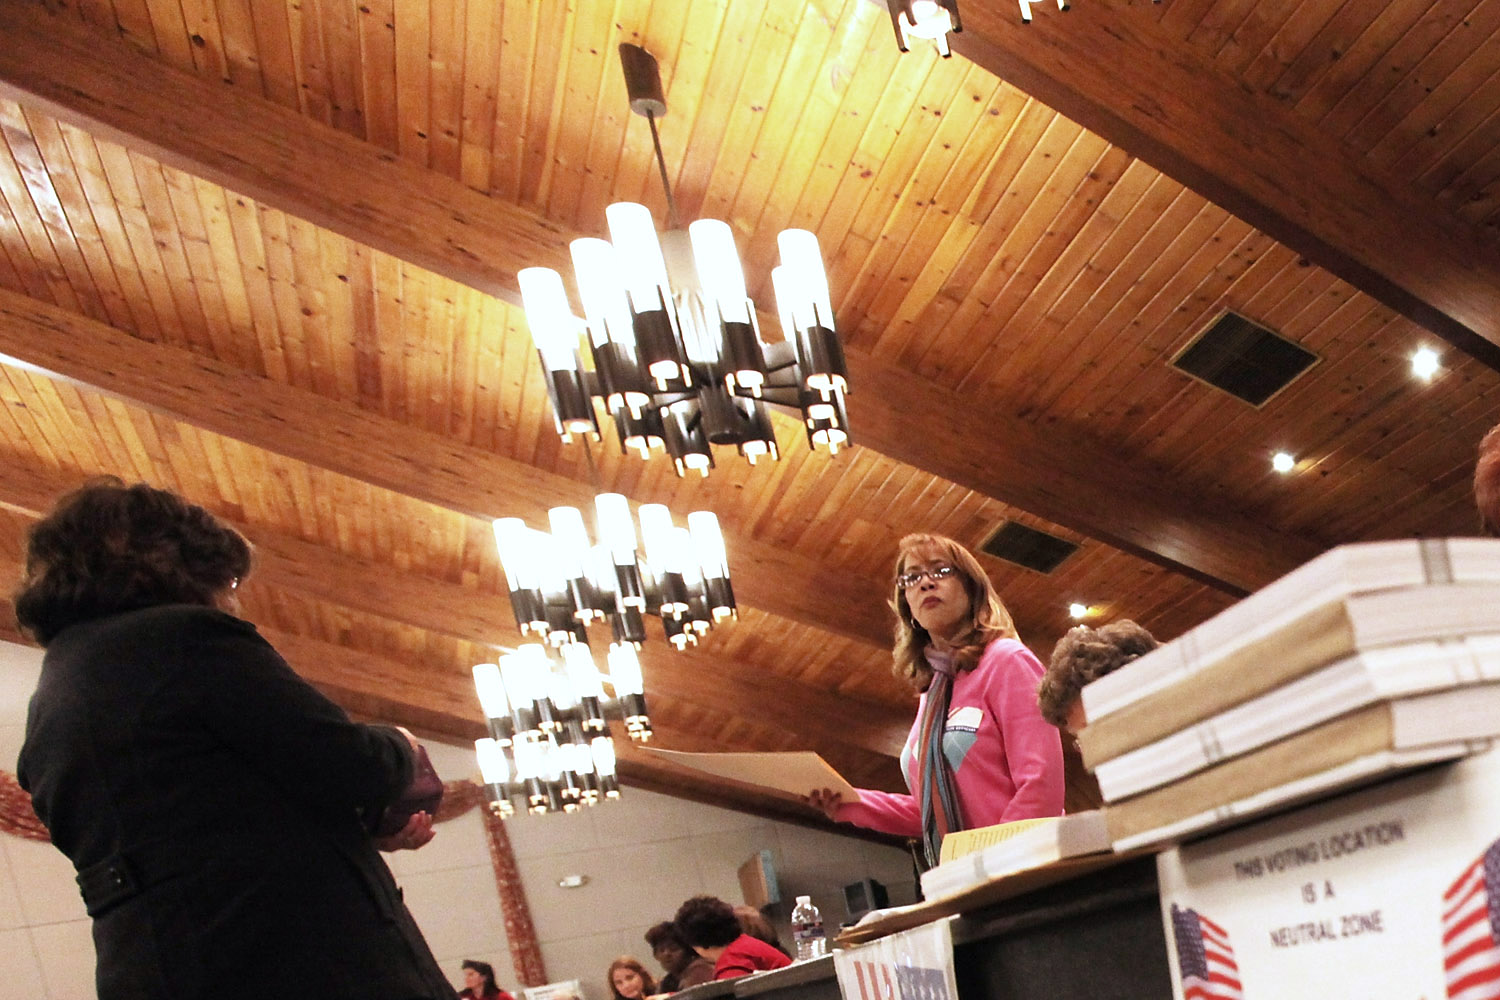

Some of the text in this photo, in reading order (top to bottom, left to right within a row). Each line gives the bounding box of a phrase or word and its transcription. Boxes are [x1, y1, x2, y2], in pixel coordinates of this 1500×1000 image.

[1265, 842, 1319, 874] VOTING
[1321, 819, 1405, 860] LOCATION
[1302, 879, 1336, 904] IS A
[1269, 909, 1384, 948] NEUTRAL ZONE
